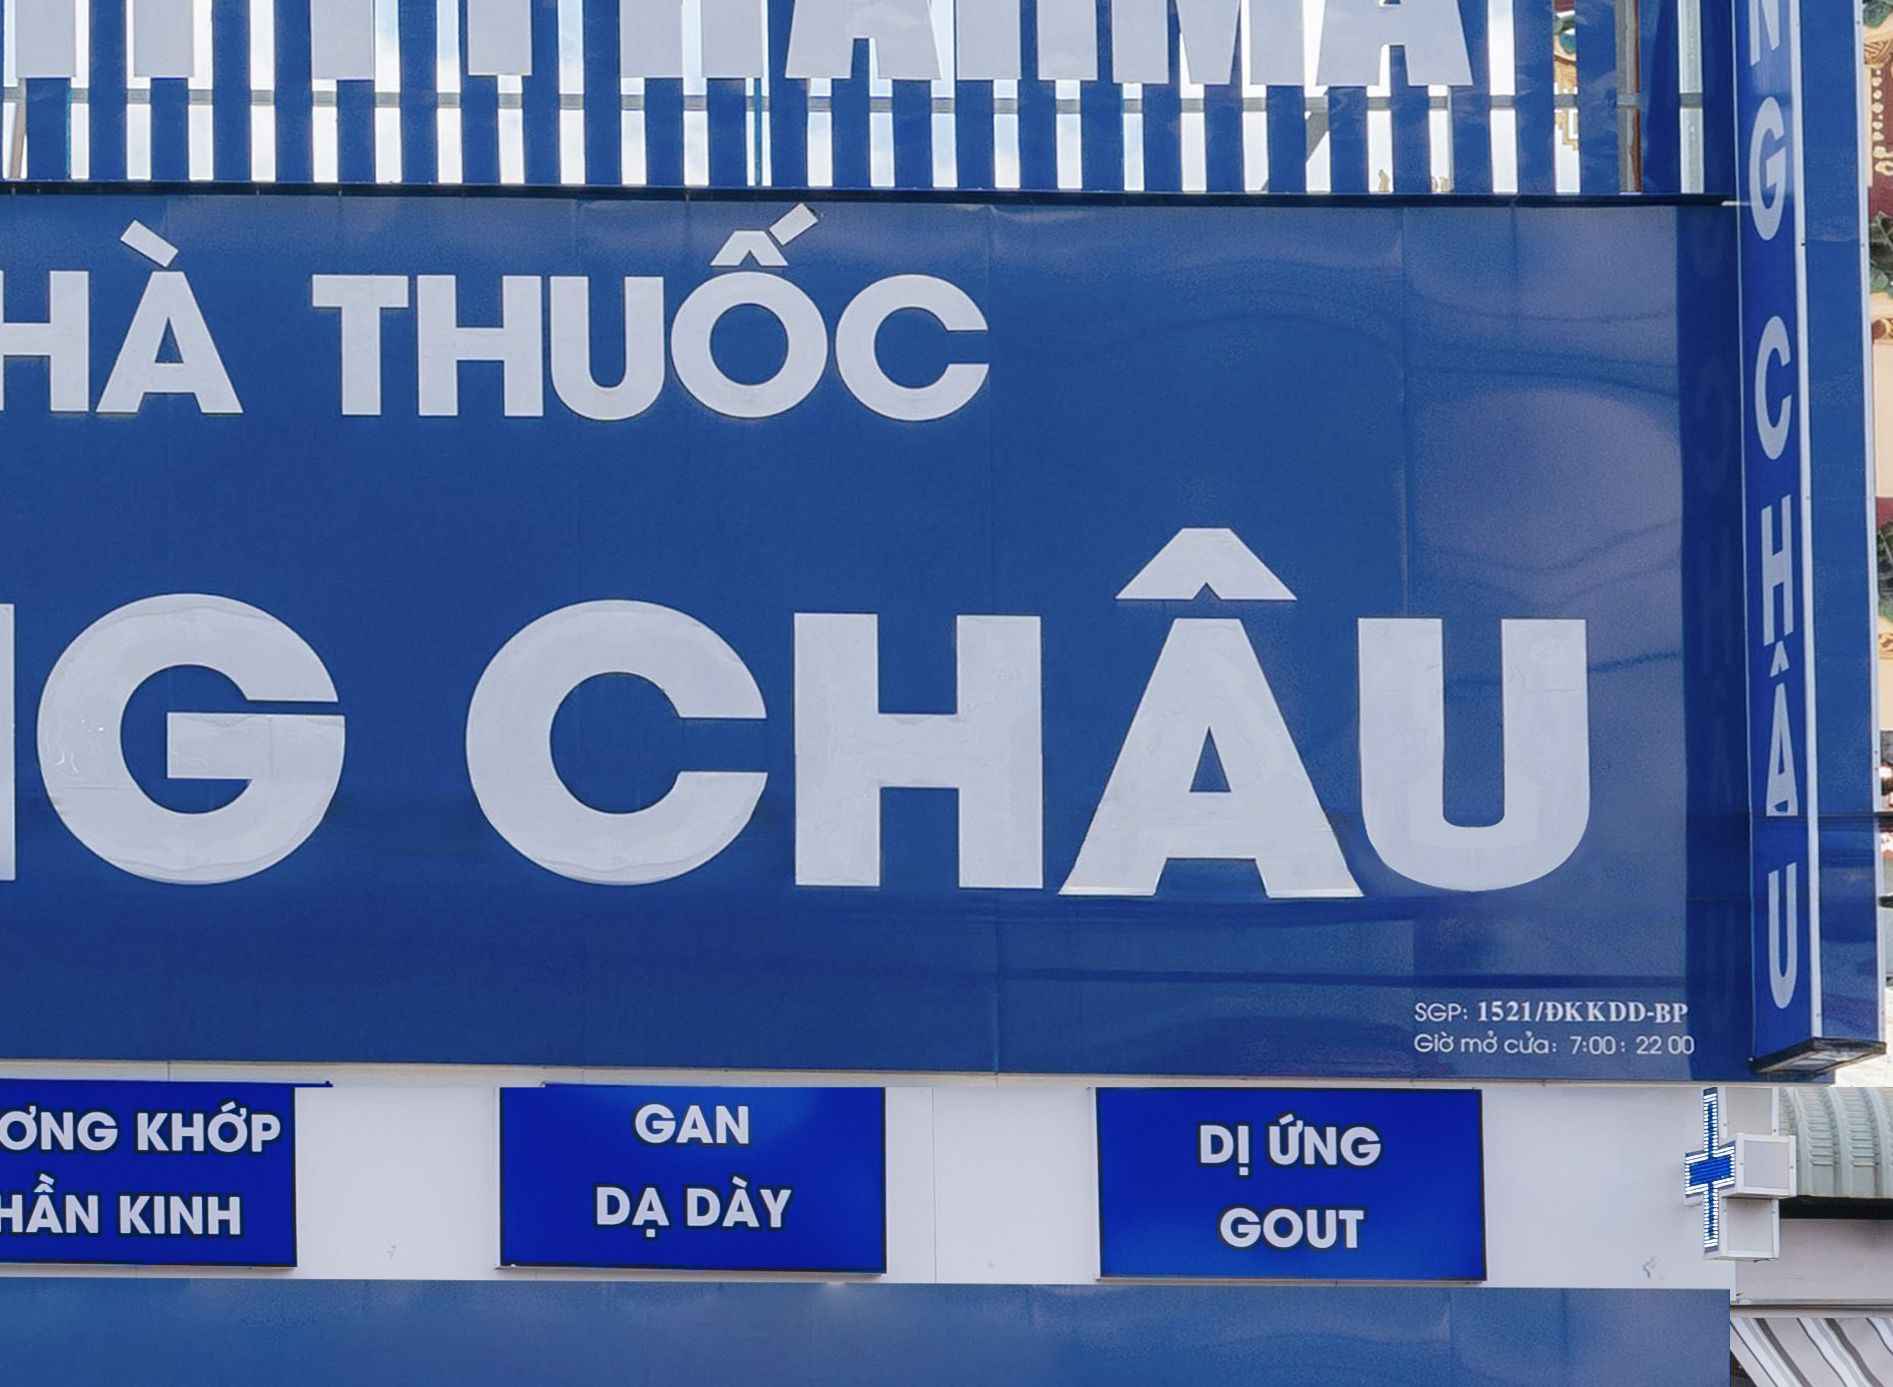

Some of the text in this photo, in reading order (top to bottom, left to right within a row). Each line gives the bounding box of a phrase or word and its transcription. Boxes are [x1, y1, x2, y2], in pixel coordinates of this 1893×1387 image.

[312, 203, 991, 421] THUỐC
[1754, 314, 1798, 1012] CHÂU
[466, 527, 1591, 897] CHÂU
[1414, 1002, 1468, 1022] SGP:
[136, 1101, 282, 1155] KHỚP
[634, 1103, 749, 1146] GAN
[1267, 1111, 1382, 1169] ỨNG
[118, 1195, 242, 1237] KINH
[596, 1178, 793, 1236] DẠ DÀY
[1219, 1205, 1365, 1251] GOUT
